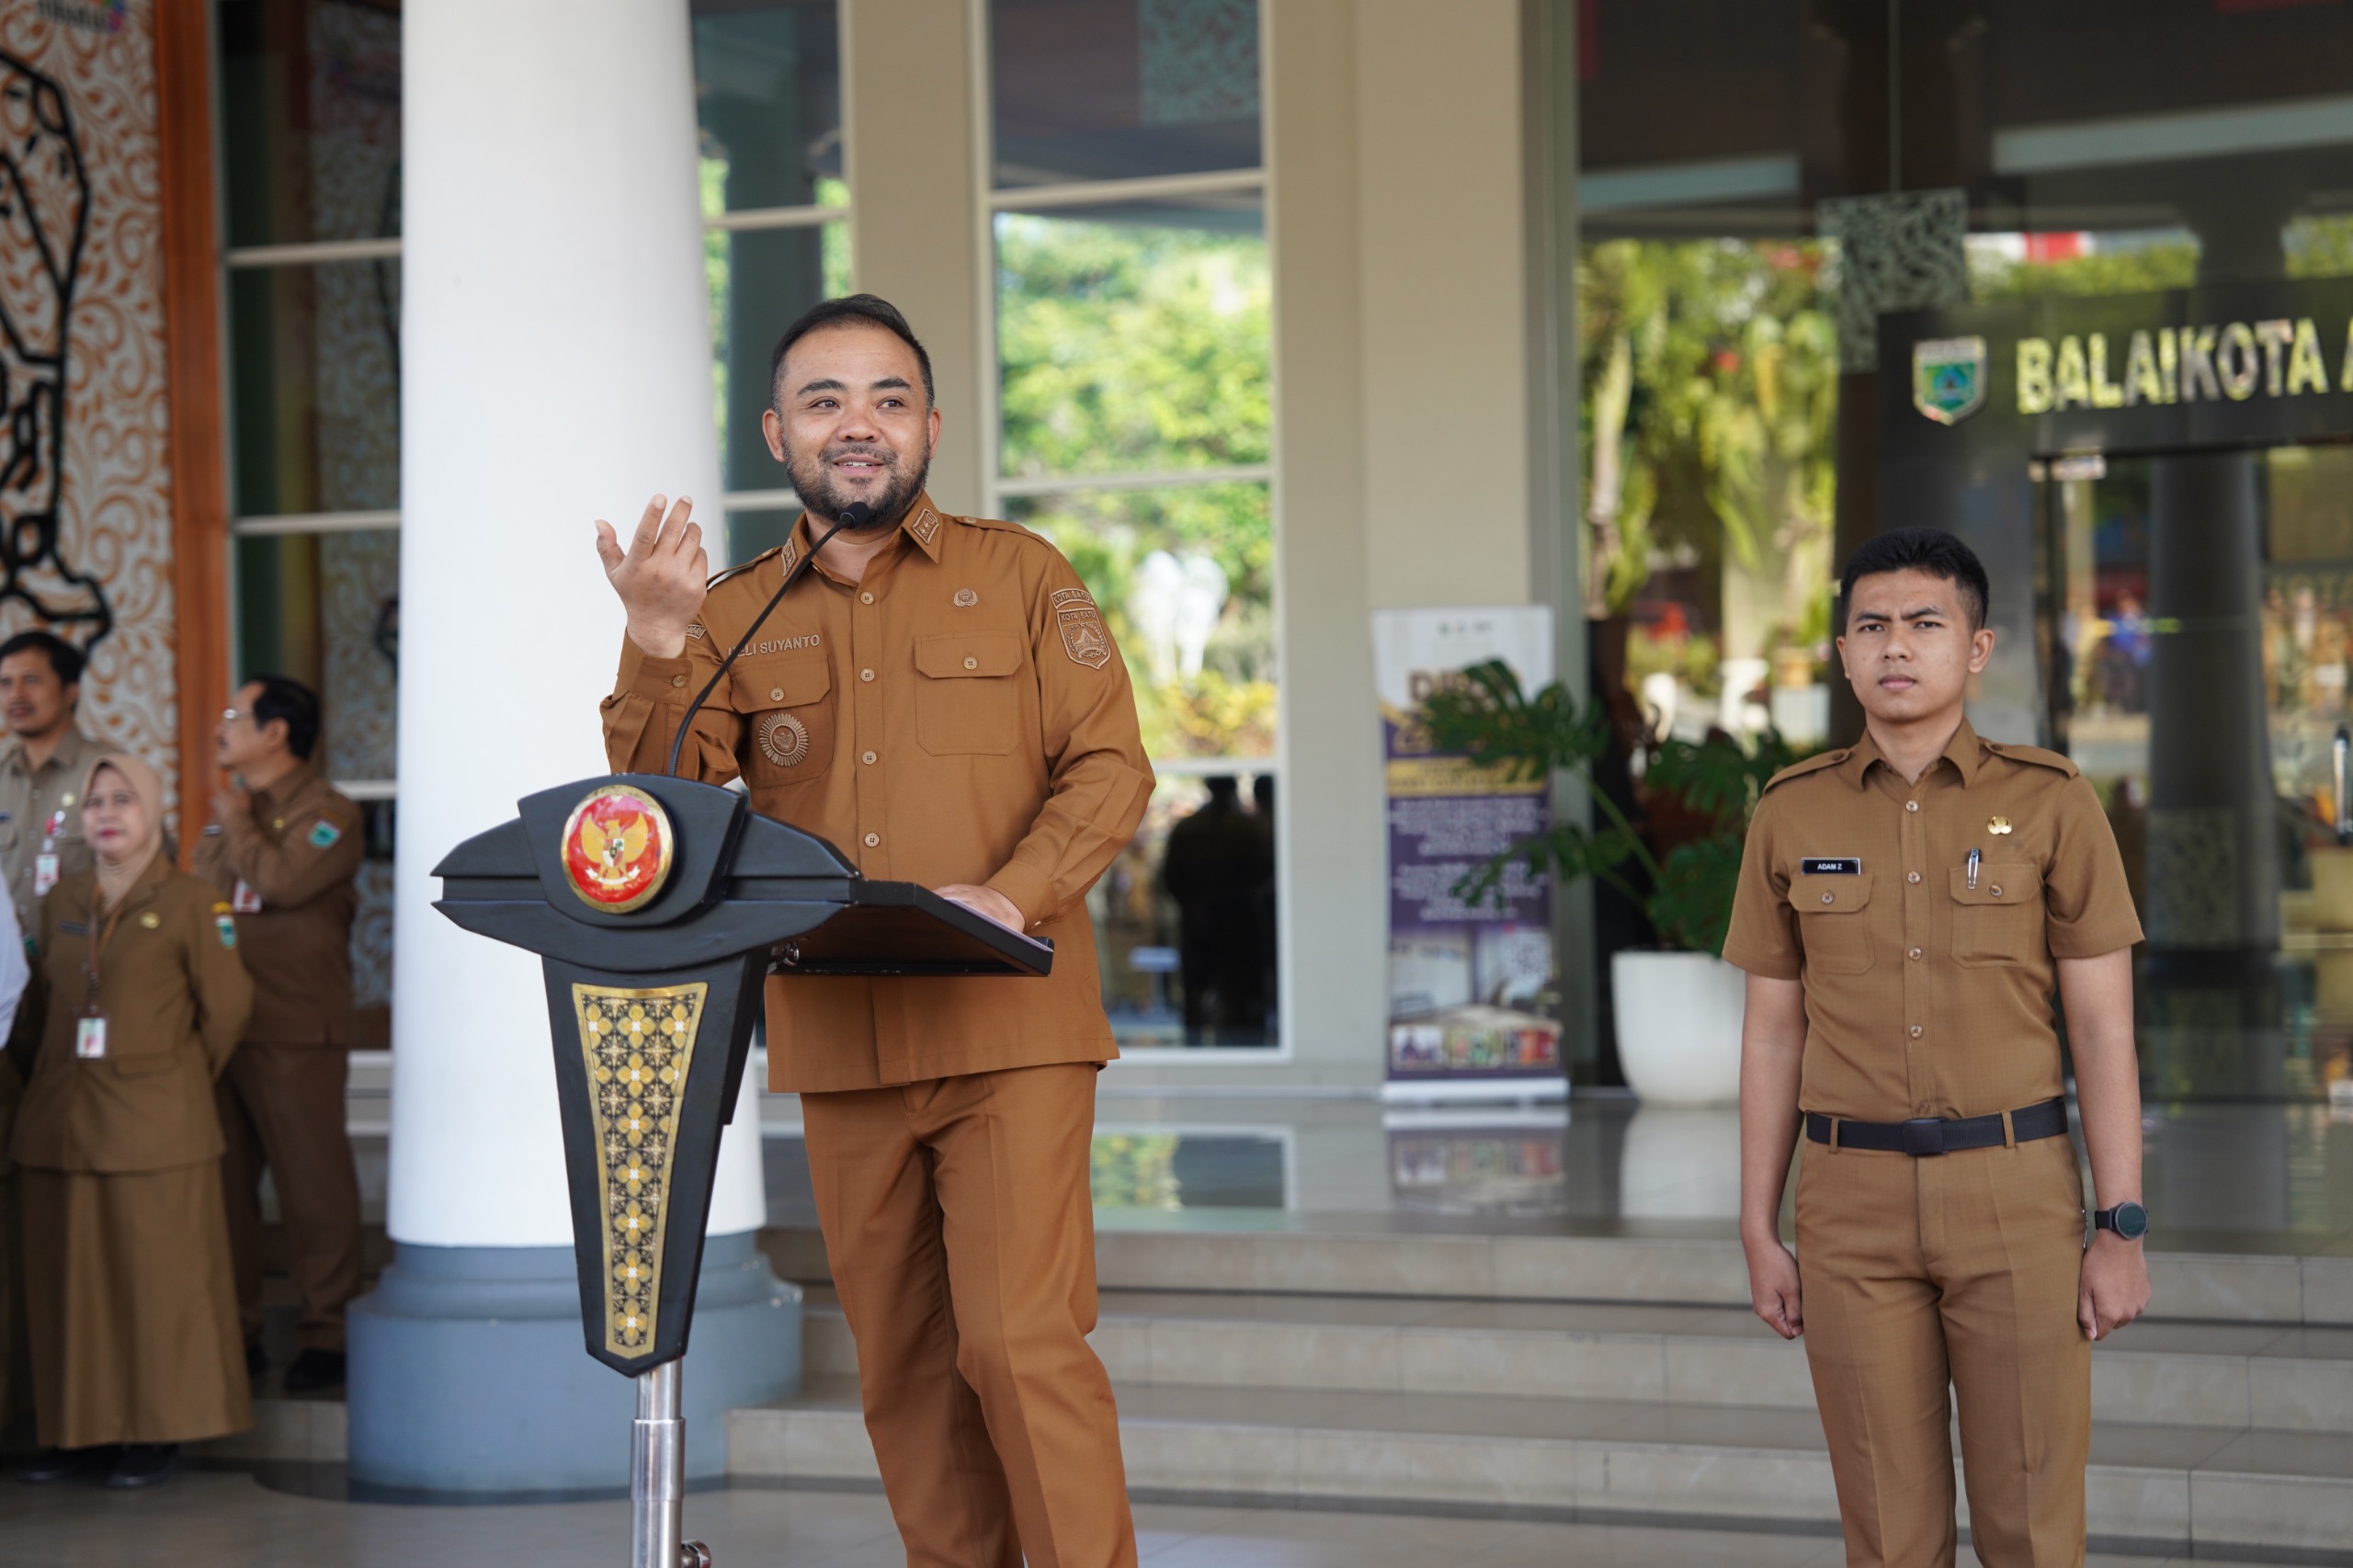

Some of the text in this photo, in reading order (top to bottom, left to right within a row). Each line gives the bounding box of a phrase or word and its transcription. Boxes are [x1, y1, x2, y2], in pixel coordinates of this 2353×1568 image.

[1053, 590, 1092, 604] KOTA BATU
[1060, 612, 1078, 621] KOTA
[759, 634, 820, 654] SUYANTO
